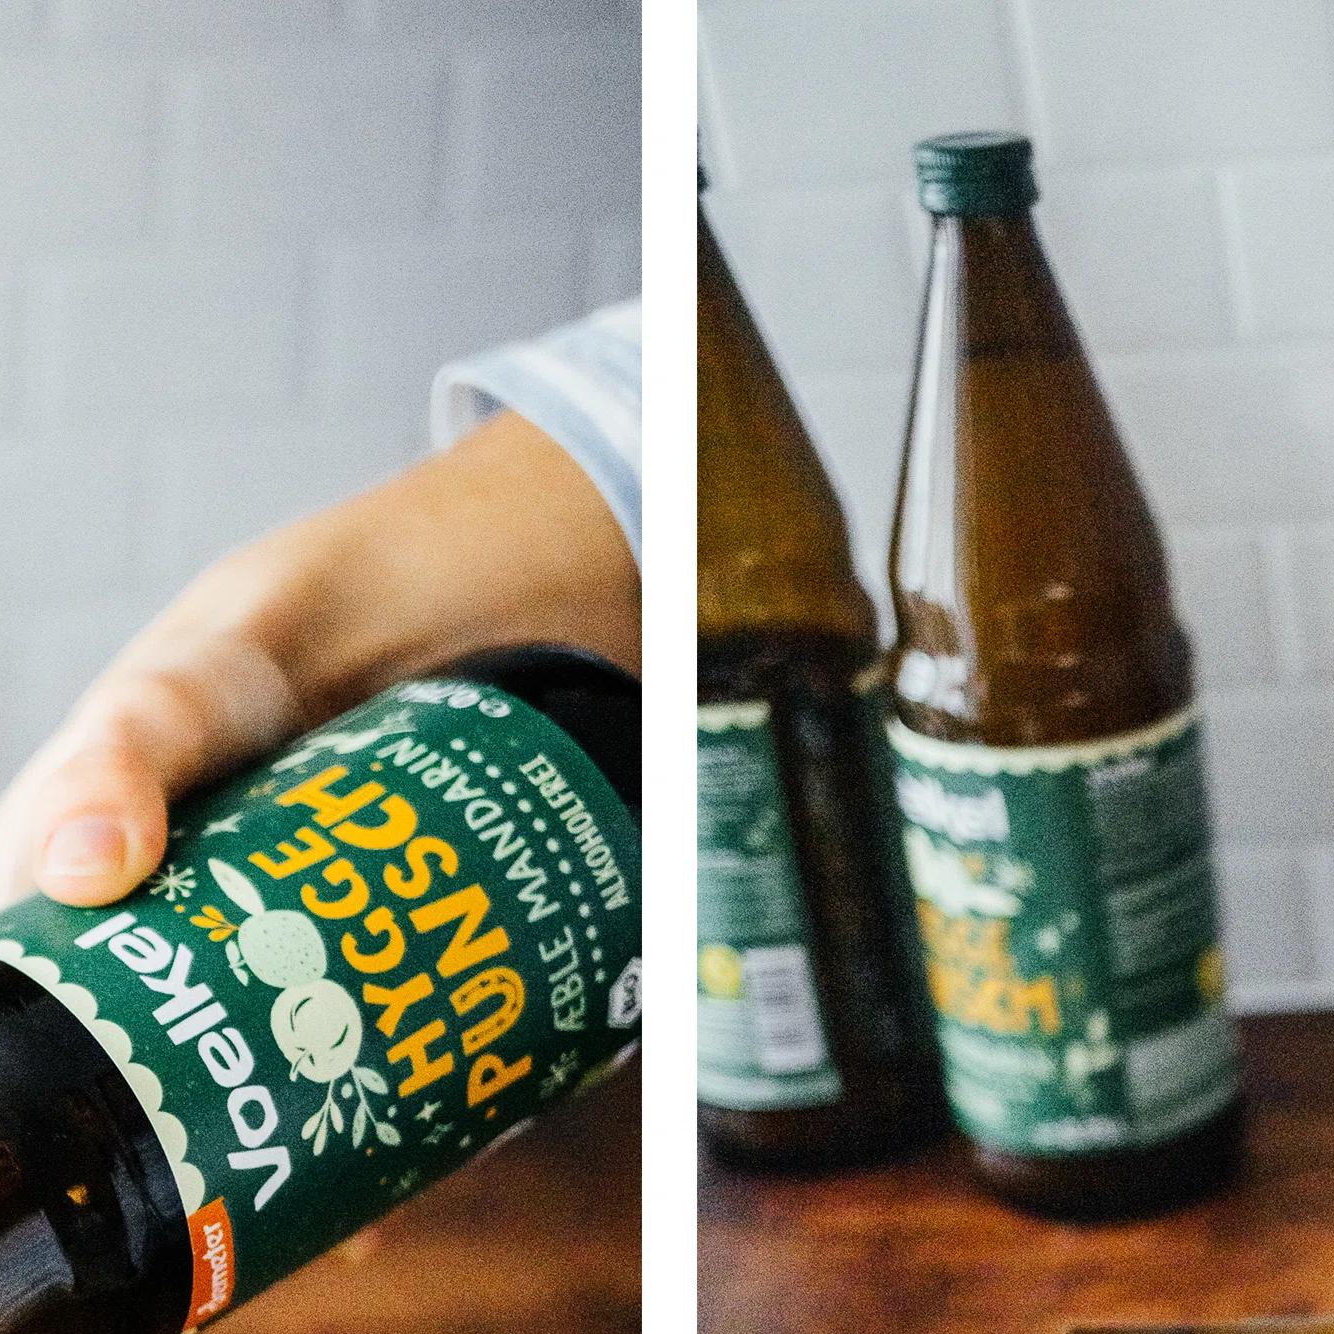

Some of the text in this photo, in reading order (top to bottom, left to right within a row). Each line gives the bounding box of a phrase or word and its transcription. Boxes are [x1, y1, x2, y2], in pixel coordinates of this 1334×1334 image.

[274, 765, 533, 1107] PUNSCH
[375, 737, 560, 923] MANDARIN
[519, 752, 630, 911] ALKOHOLFREI
[248, 827, 455, 1098] HYGGE
